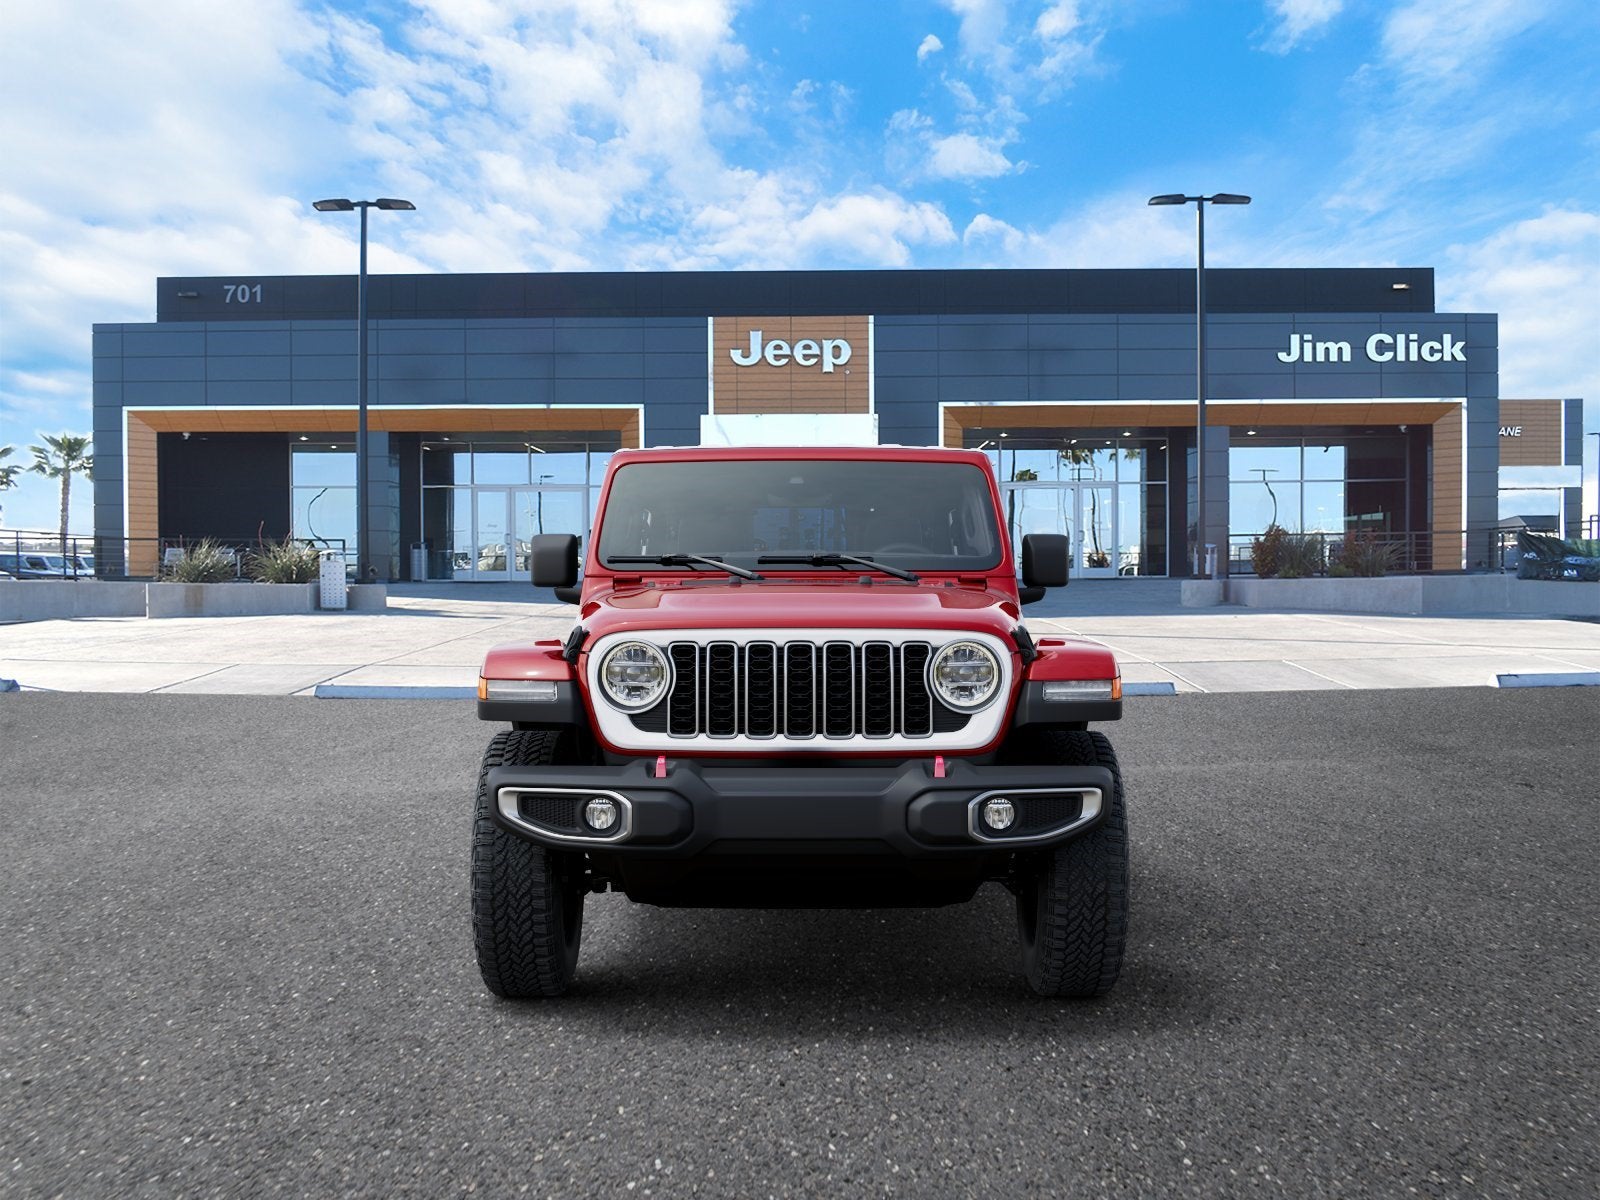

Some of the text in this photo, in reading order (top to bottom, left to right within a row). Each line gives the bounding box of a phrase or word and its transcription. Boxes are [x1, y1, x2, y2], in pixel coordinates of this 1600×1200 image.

[223, 284, 261, 304] 701
[729, 330, 852, 373] Jeep
[1277, 333, 1467, 363] Jim Click
